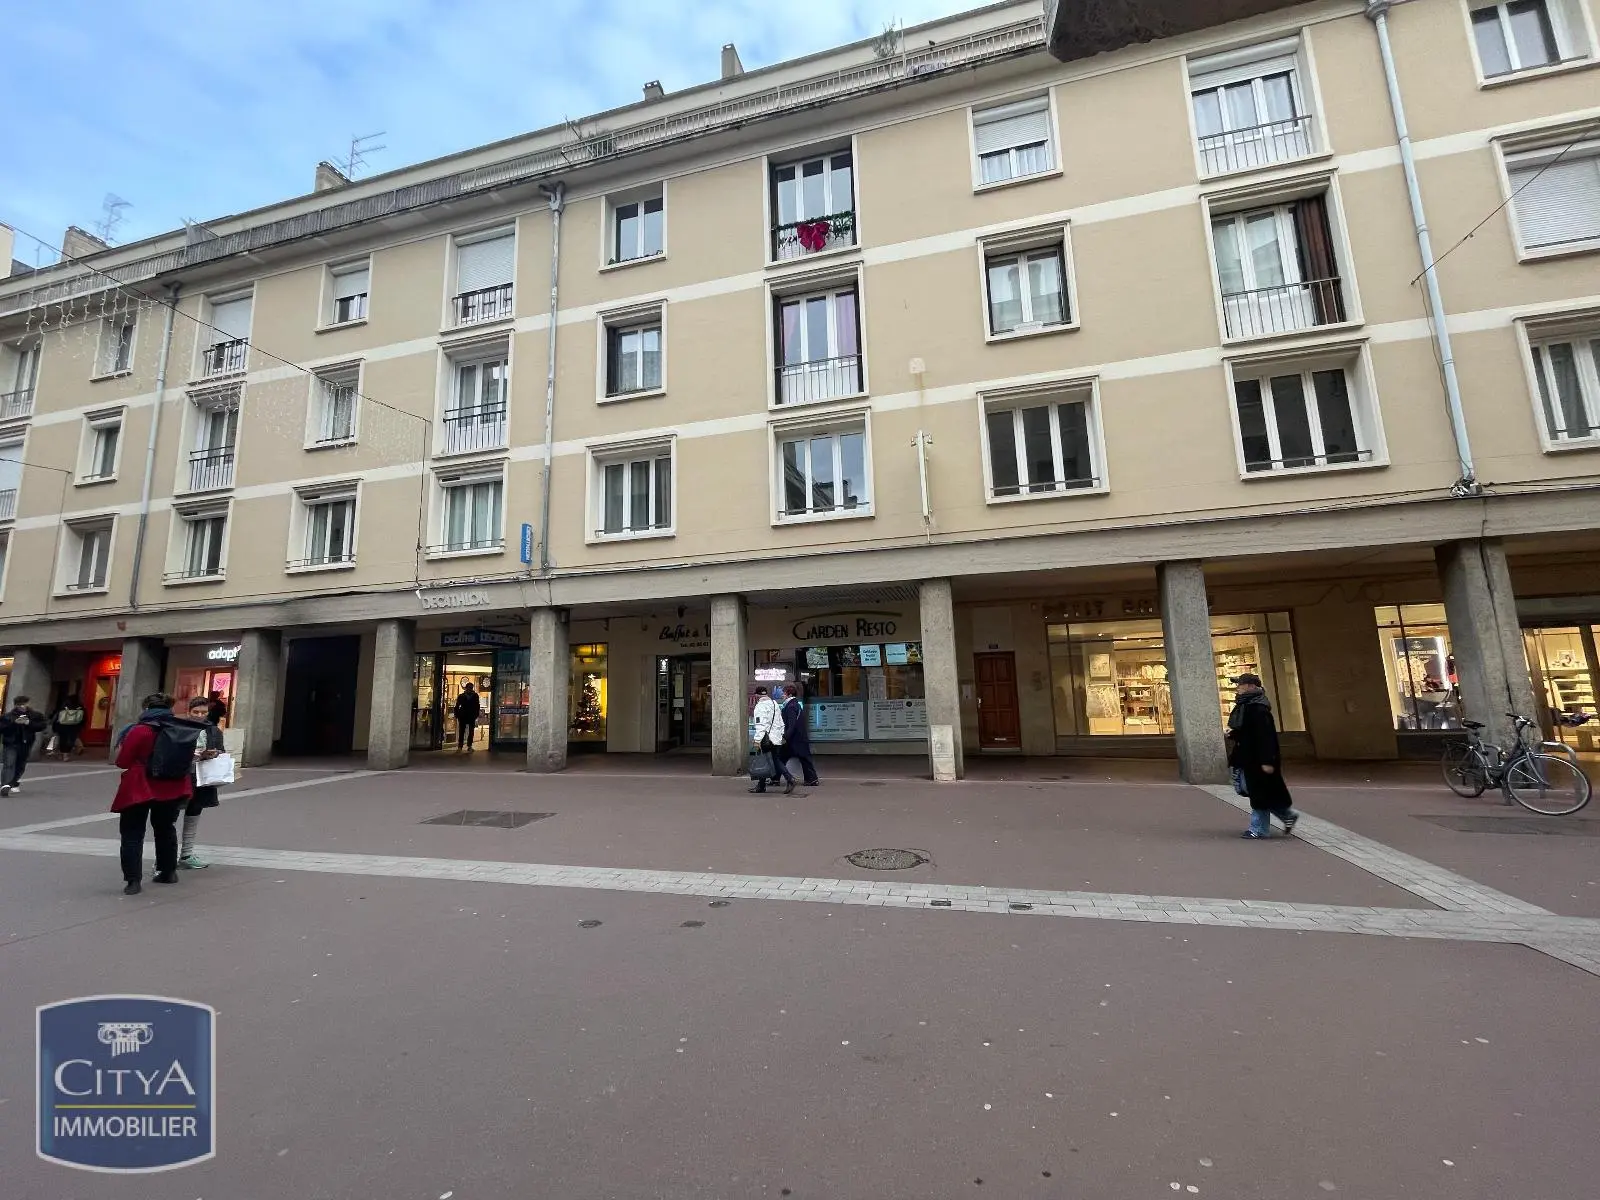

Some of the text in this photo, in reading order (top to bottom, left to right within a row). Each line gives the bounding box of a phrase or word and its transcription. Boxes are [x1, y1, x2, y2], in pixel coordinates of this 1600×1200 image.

[421, 591, 490, 610] DECATHLON
[792, 618, 897, 641] GARDEN RESTO
